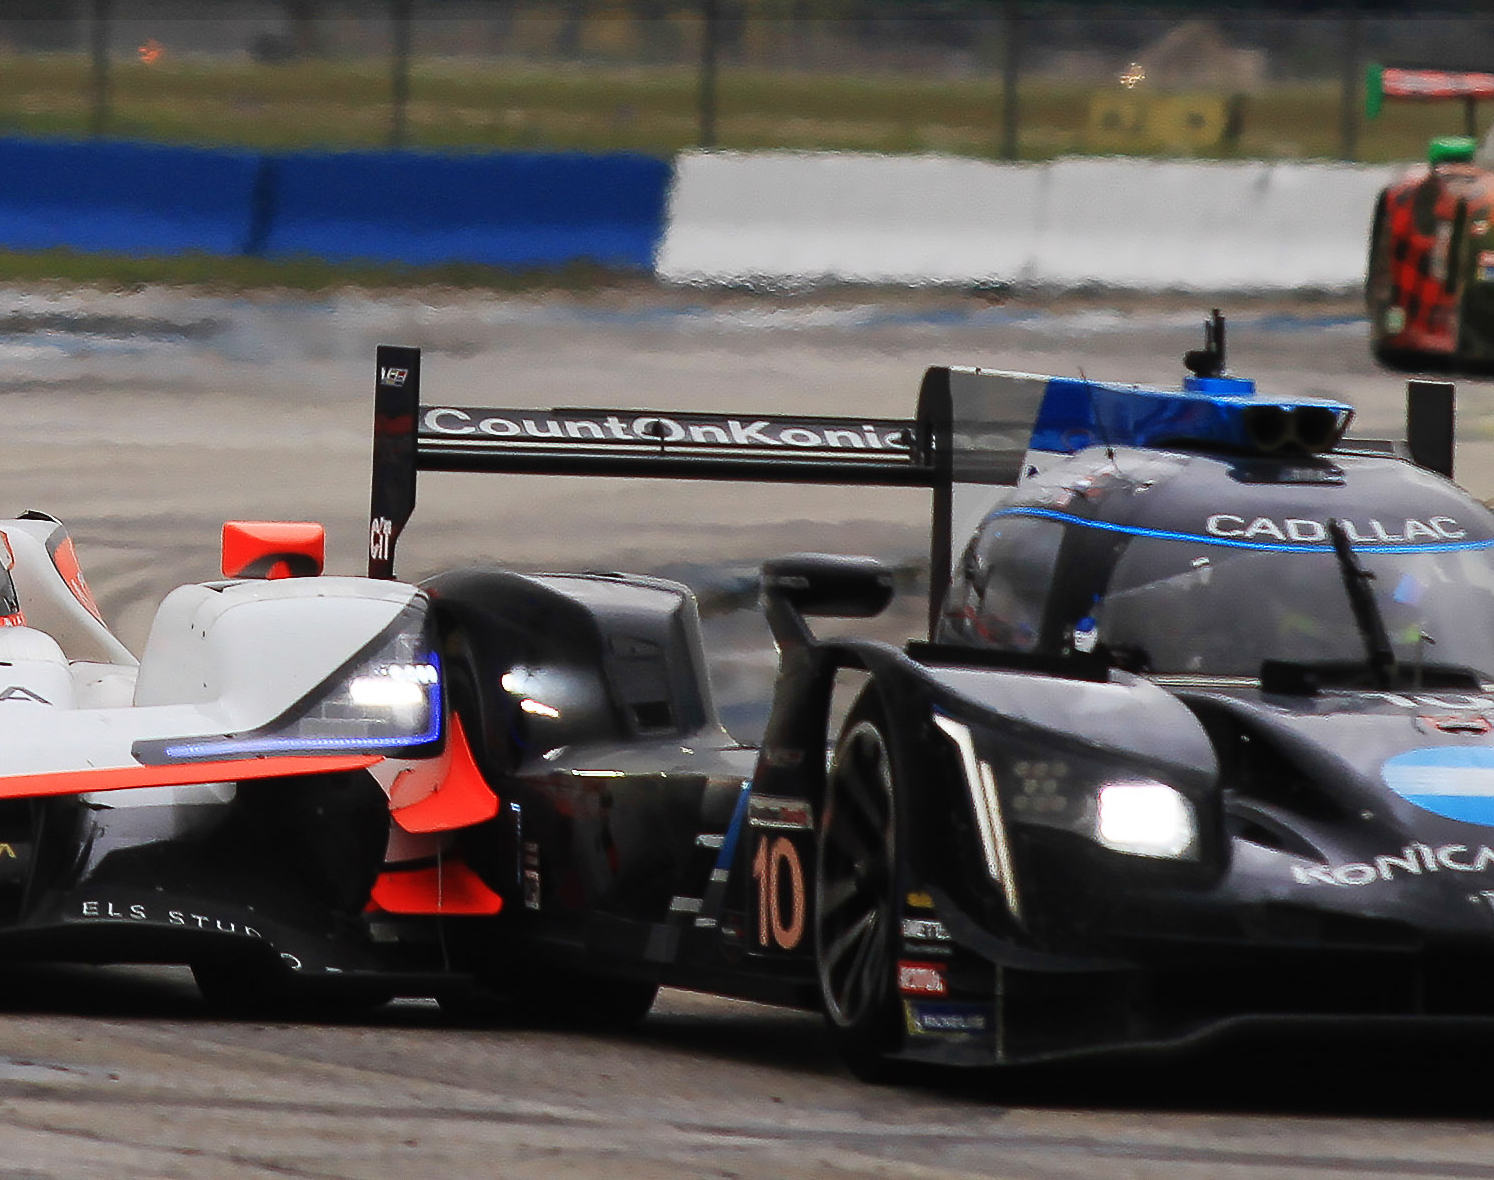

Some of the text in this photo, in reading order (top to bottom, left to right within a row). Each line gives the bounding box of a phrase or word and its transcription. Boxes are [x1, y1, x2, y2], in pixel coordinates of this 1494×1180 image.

[1205, 514, 1466, 543] CADLLAC
[753, 834, 805, 951] 10
[82, 900, 147, 920] ELS
